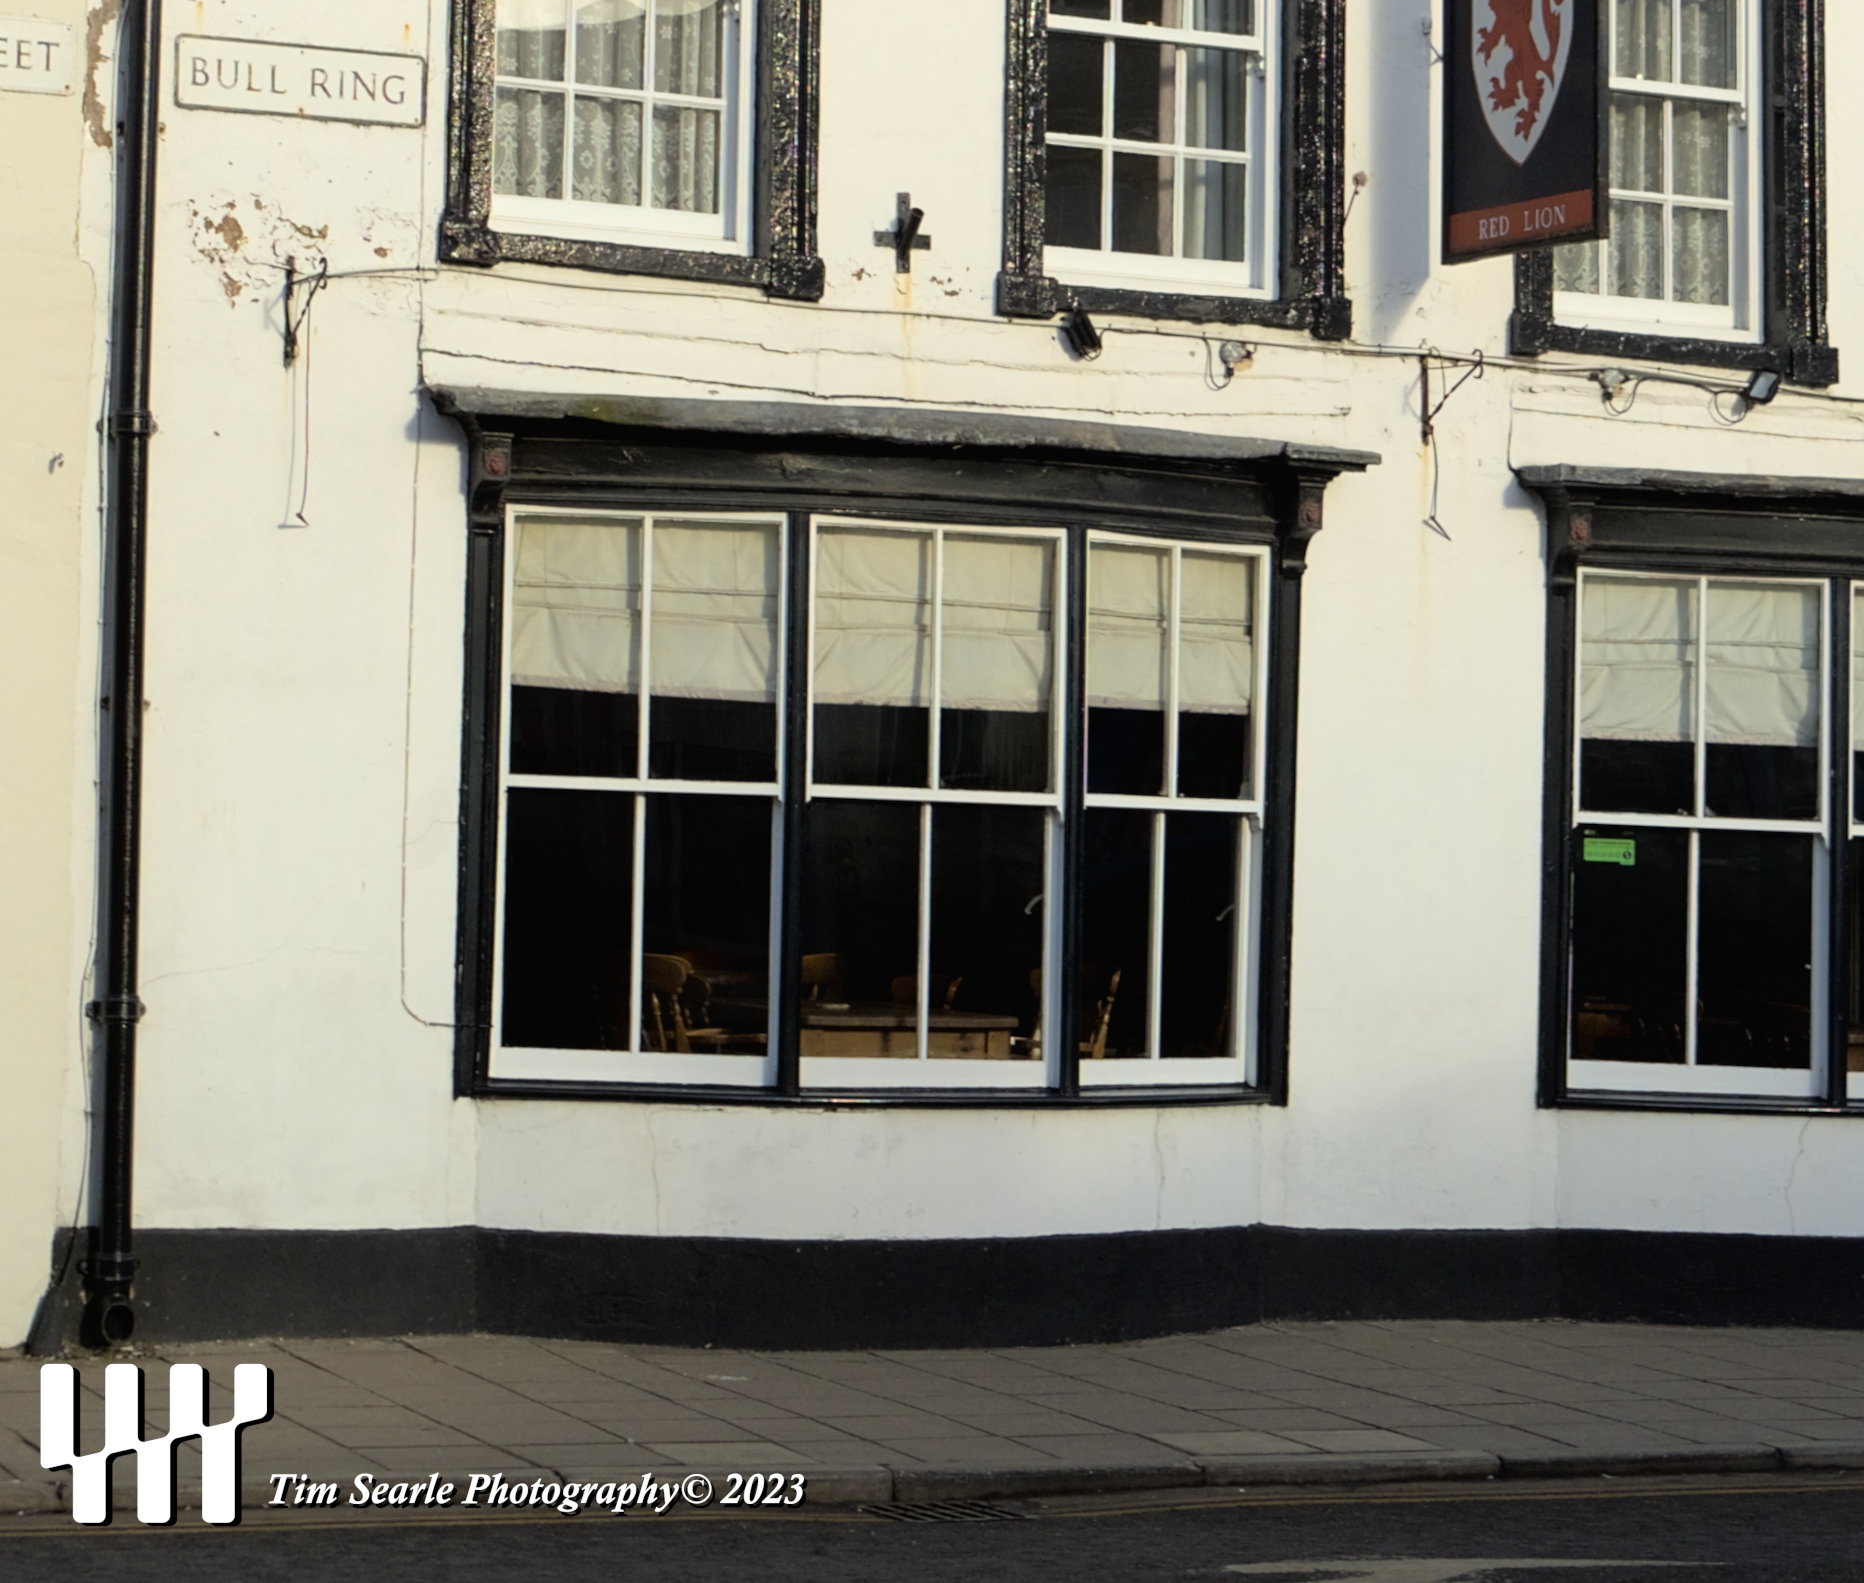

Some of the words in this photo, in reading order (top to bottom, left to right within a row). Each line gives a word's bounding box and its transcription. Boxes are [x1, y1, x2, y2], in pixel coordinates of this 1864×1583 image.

[190, 56, 287, 94] BULL
[310, 67, 407, 104] RING
[1477, 215, 1511, 241] RED
[1523, 204, 1566, 232] LION
